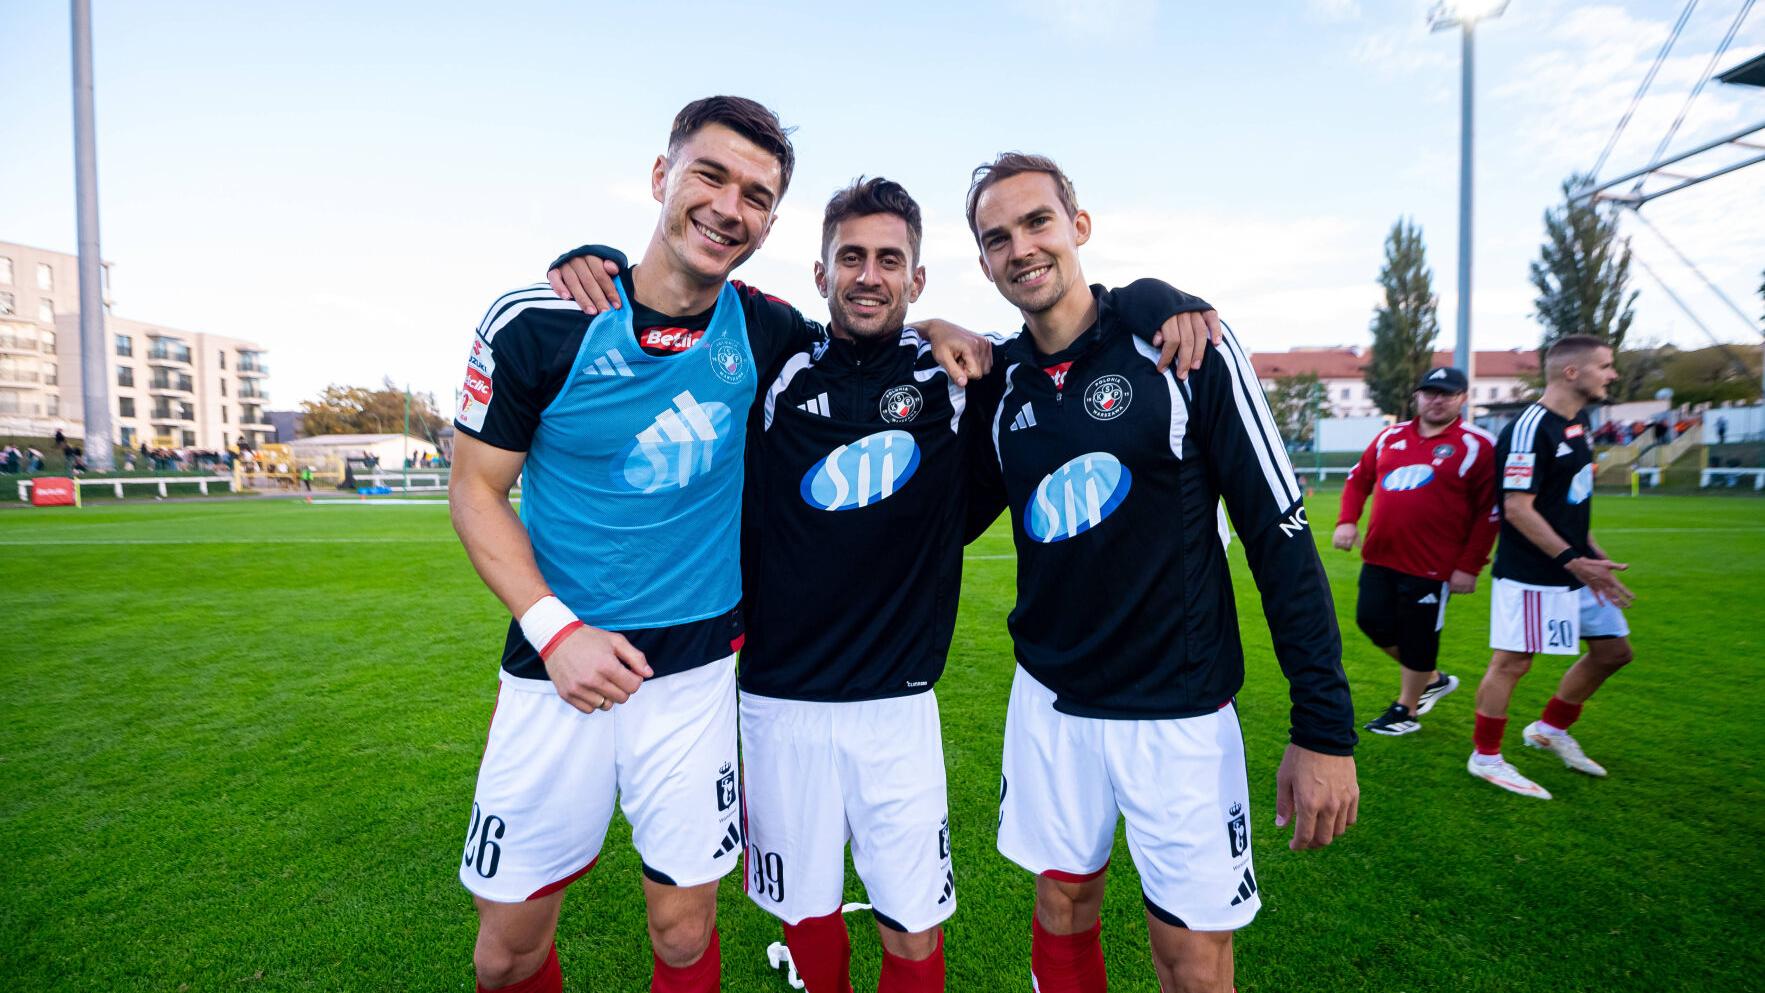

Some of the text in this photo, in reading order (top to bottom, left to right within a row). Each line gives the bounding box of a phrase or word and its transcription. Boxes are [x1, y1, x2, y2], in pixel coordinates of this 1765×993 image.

[468, 356, 487, 373] UZUKI
[1094, 377, 1121, 388] POLONIA
[1092, 406, 1124, 418] WARSZAWA
[824, 434, 895, 512] Sii
[1036, 456, 1102, 543] Sii
[1548, 619, 1572, 647] 20
[465, 801, 506, 878] 26
[751, 843, 784, 903] 99
